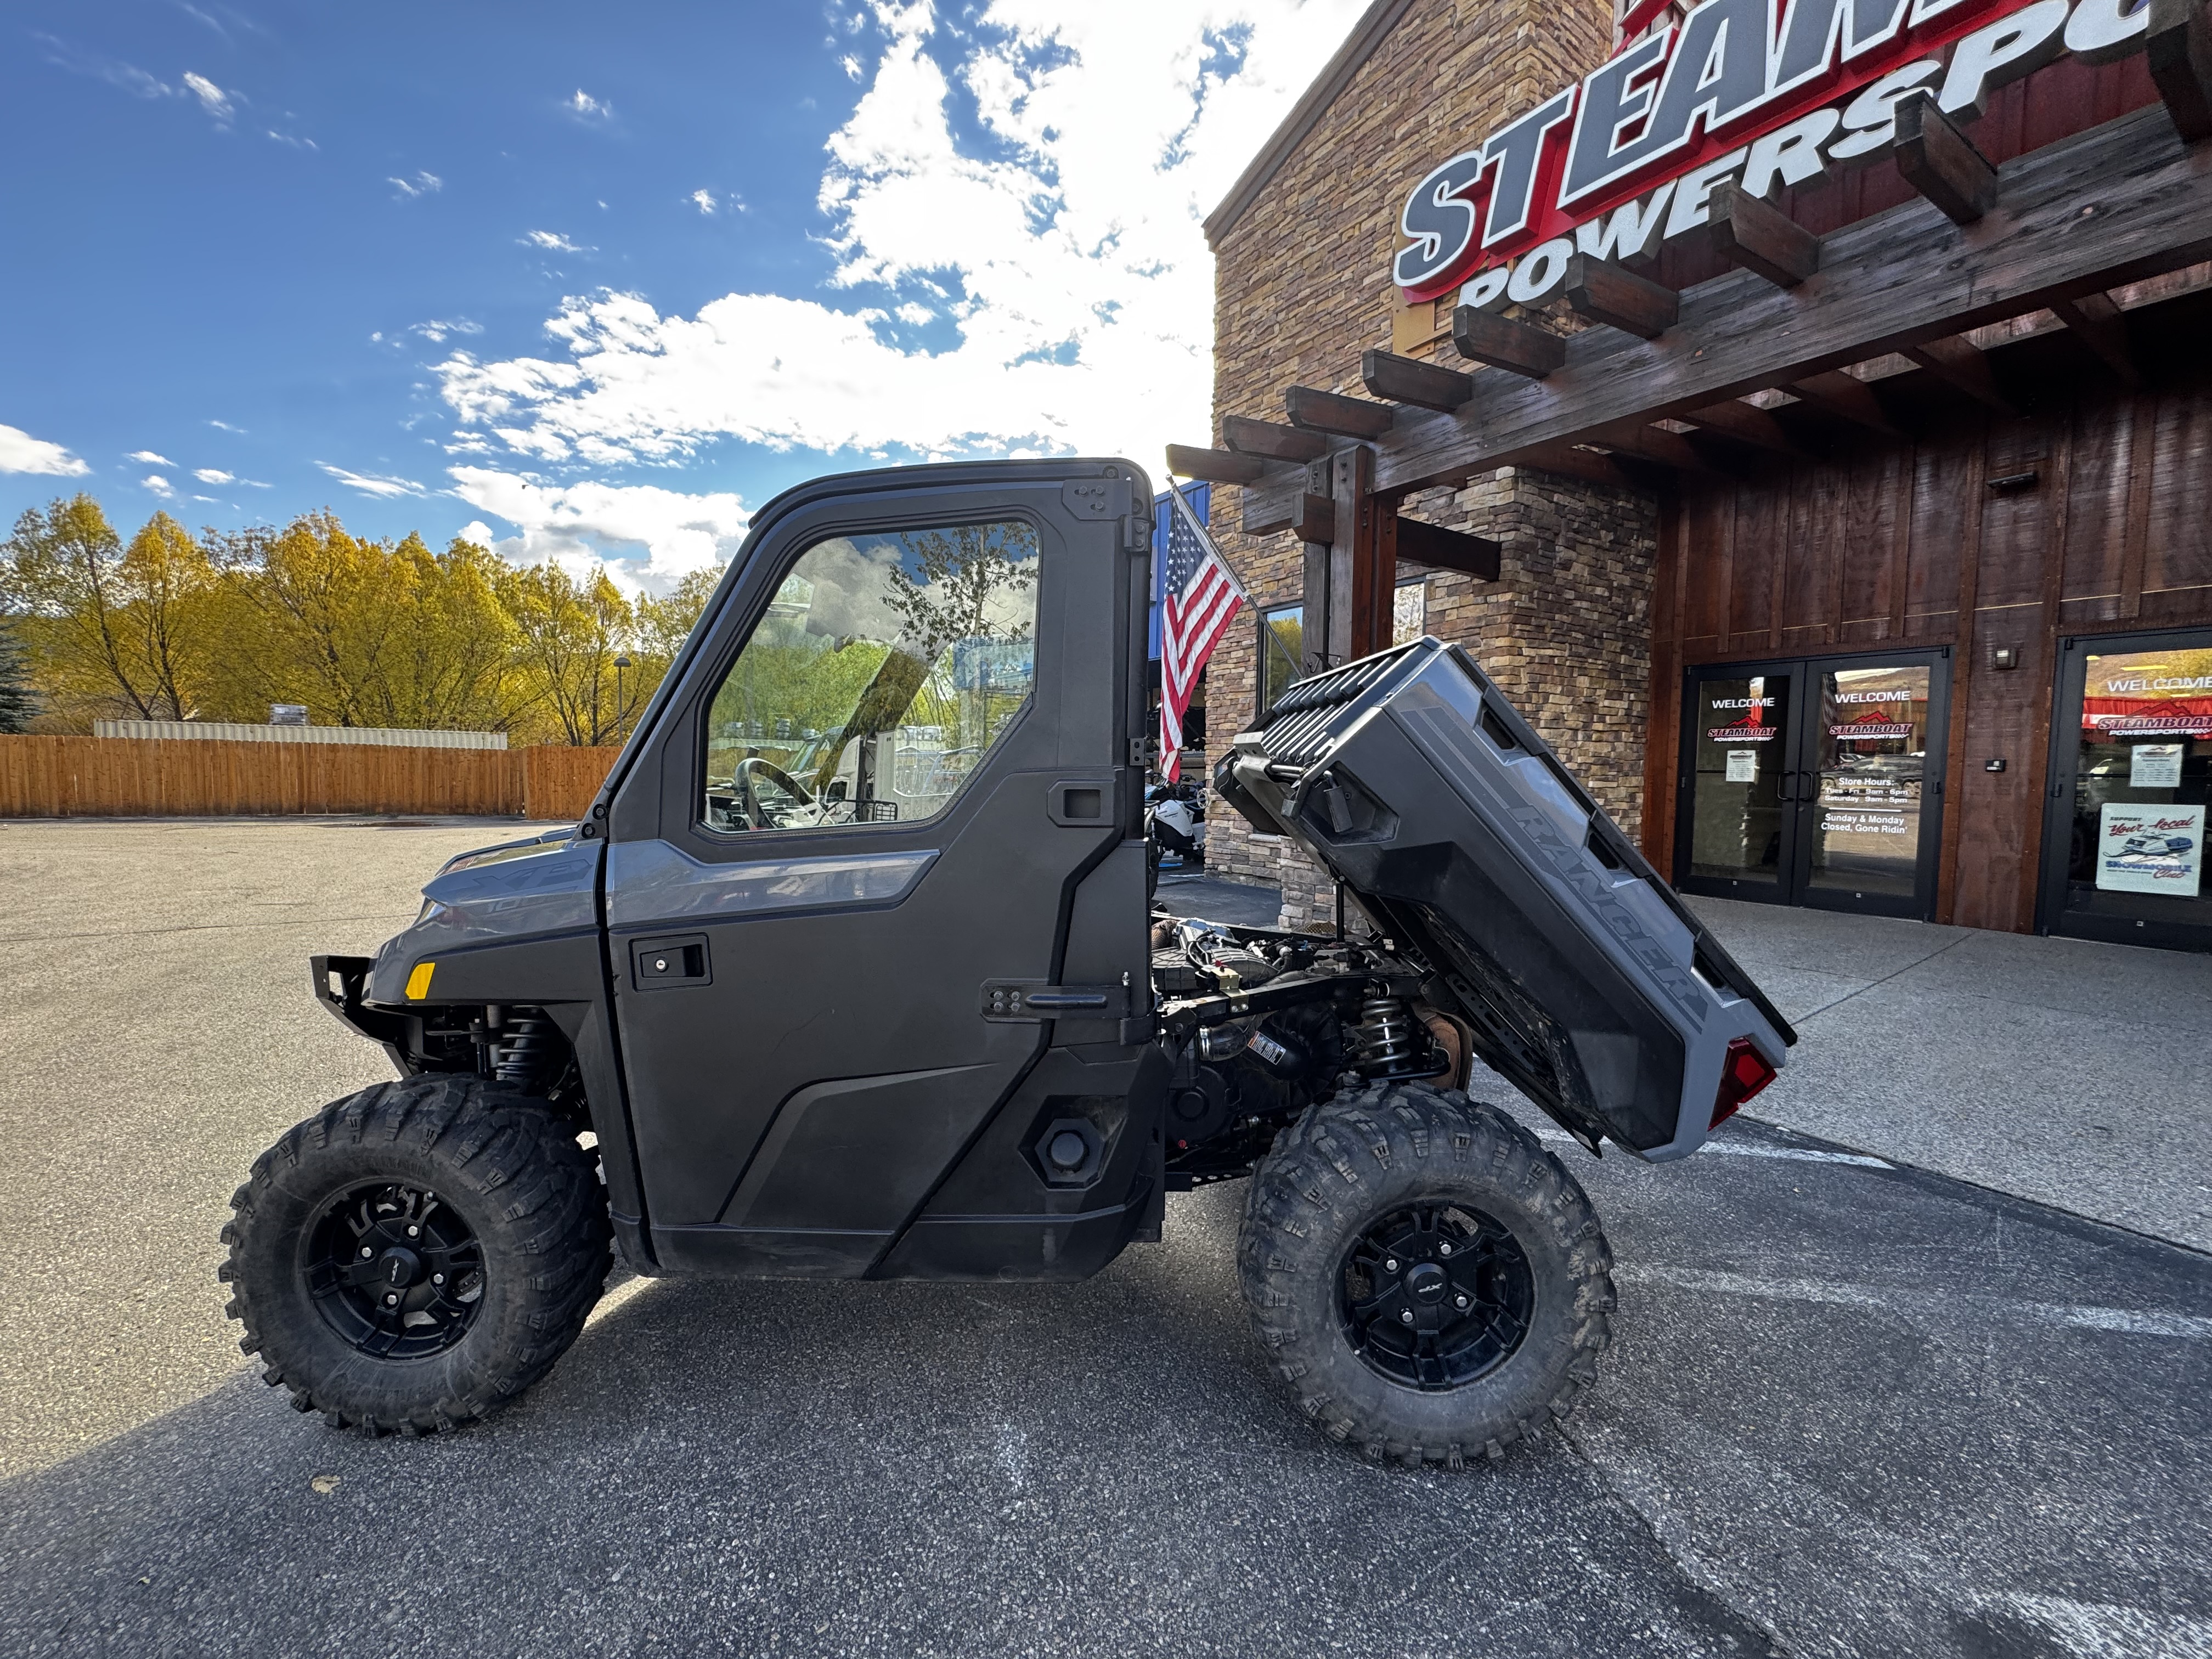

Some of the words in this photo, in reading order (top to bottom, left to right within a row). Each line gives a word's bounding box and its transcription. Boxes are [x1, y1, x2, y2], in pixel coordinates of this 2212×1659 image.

[1393, 0, 1970, 287] STEAM
[2108, 676, 2212, 692] WELCOME
[1712, 697, 1775, 709] WELCOME
[1835, 690, 1911, 703] WELCOME
[1707, 727, 1778, 737] STEAMBOAT
[1829, 723, 1913, 735] STEAMBOAT
[1838, 777, 1863, 786] Store
[1864, 778, 1894, 786] Hours:
[1825, 813, 1857, 823] Sunday
[1868, 815, 1905, 826] Monday
[1821, 822, 1853, 833] Closed,
[1855, 824, 1879, 832] Gone
[1881, 825, 1908, 834] Ridin'
[2108, 823, 2146, 837] Your
[1507, 806, 1701, 1000] RANGER
